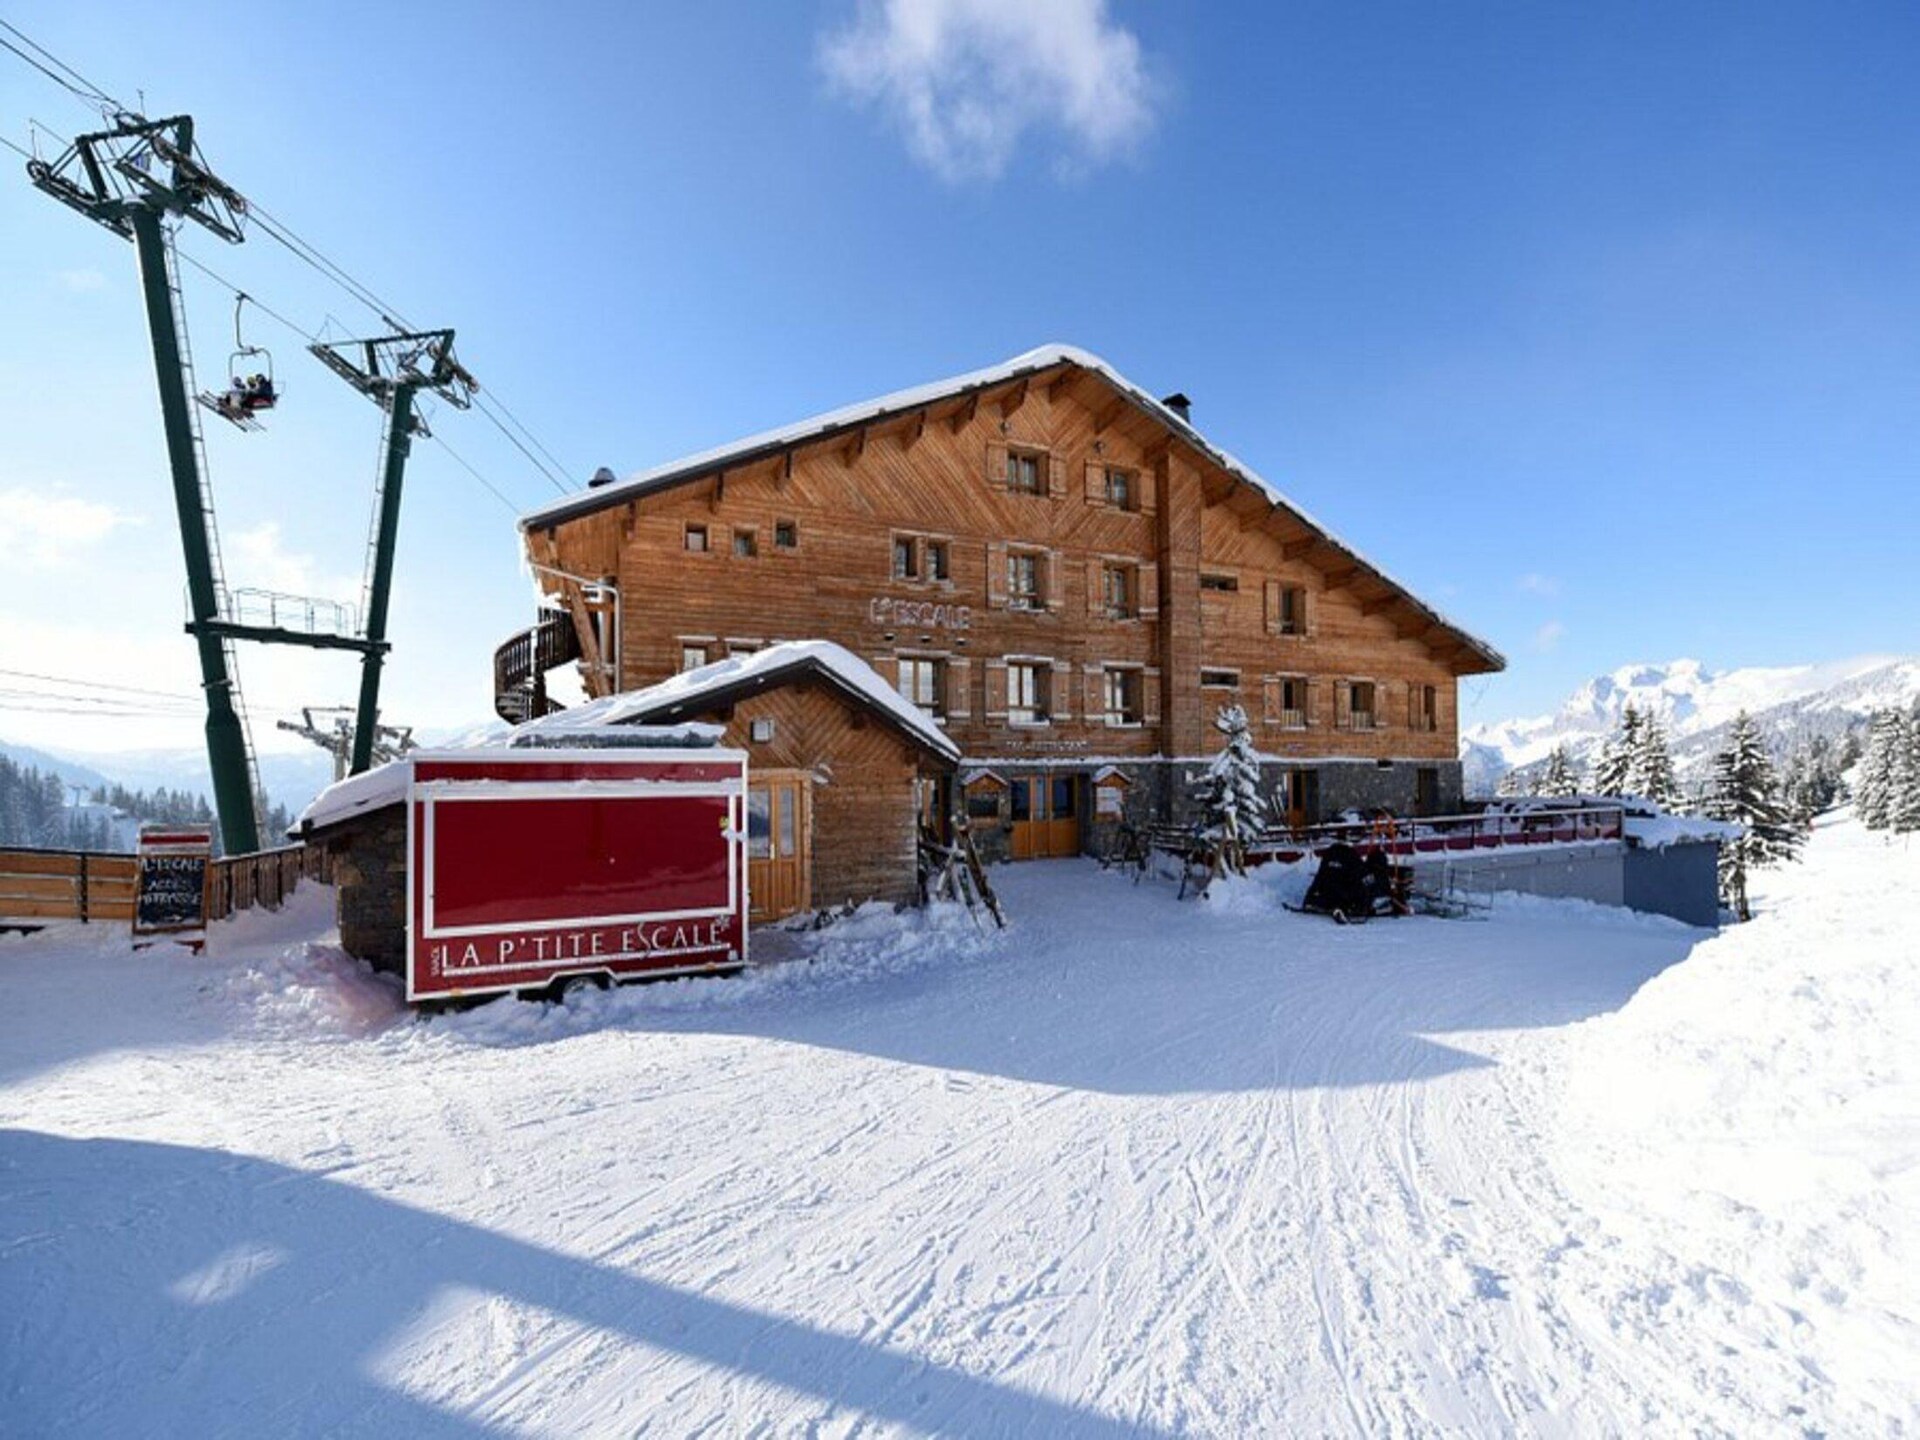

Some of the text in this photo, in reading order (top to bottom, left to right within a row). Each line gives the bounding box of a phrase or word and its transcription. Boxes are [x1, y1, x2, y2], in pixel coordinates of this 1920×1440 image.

[442, 921, 721, 970] LA P'TITE ESCALE
